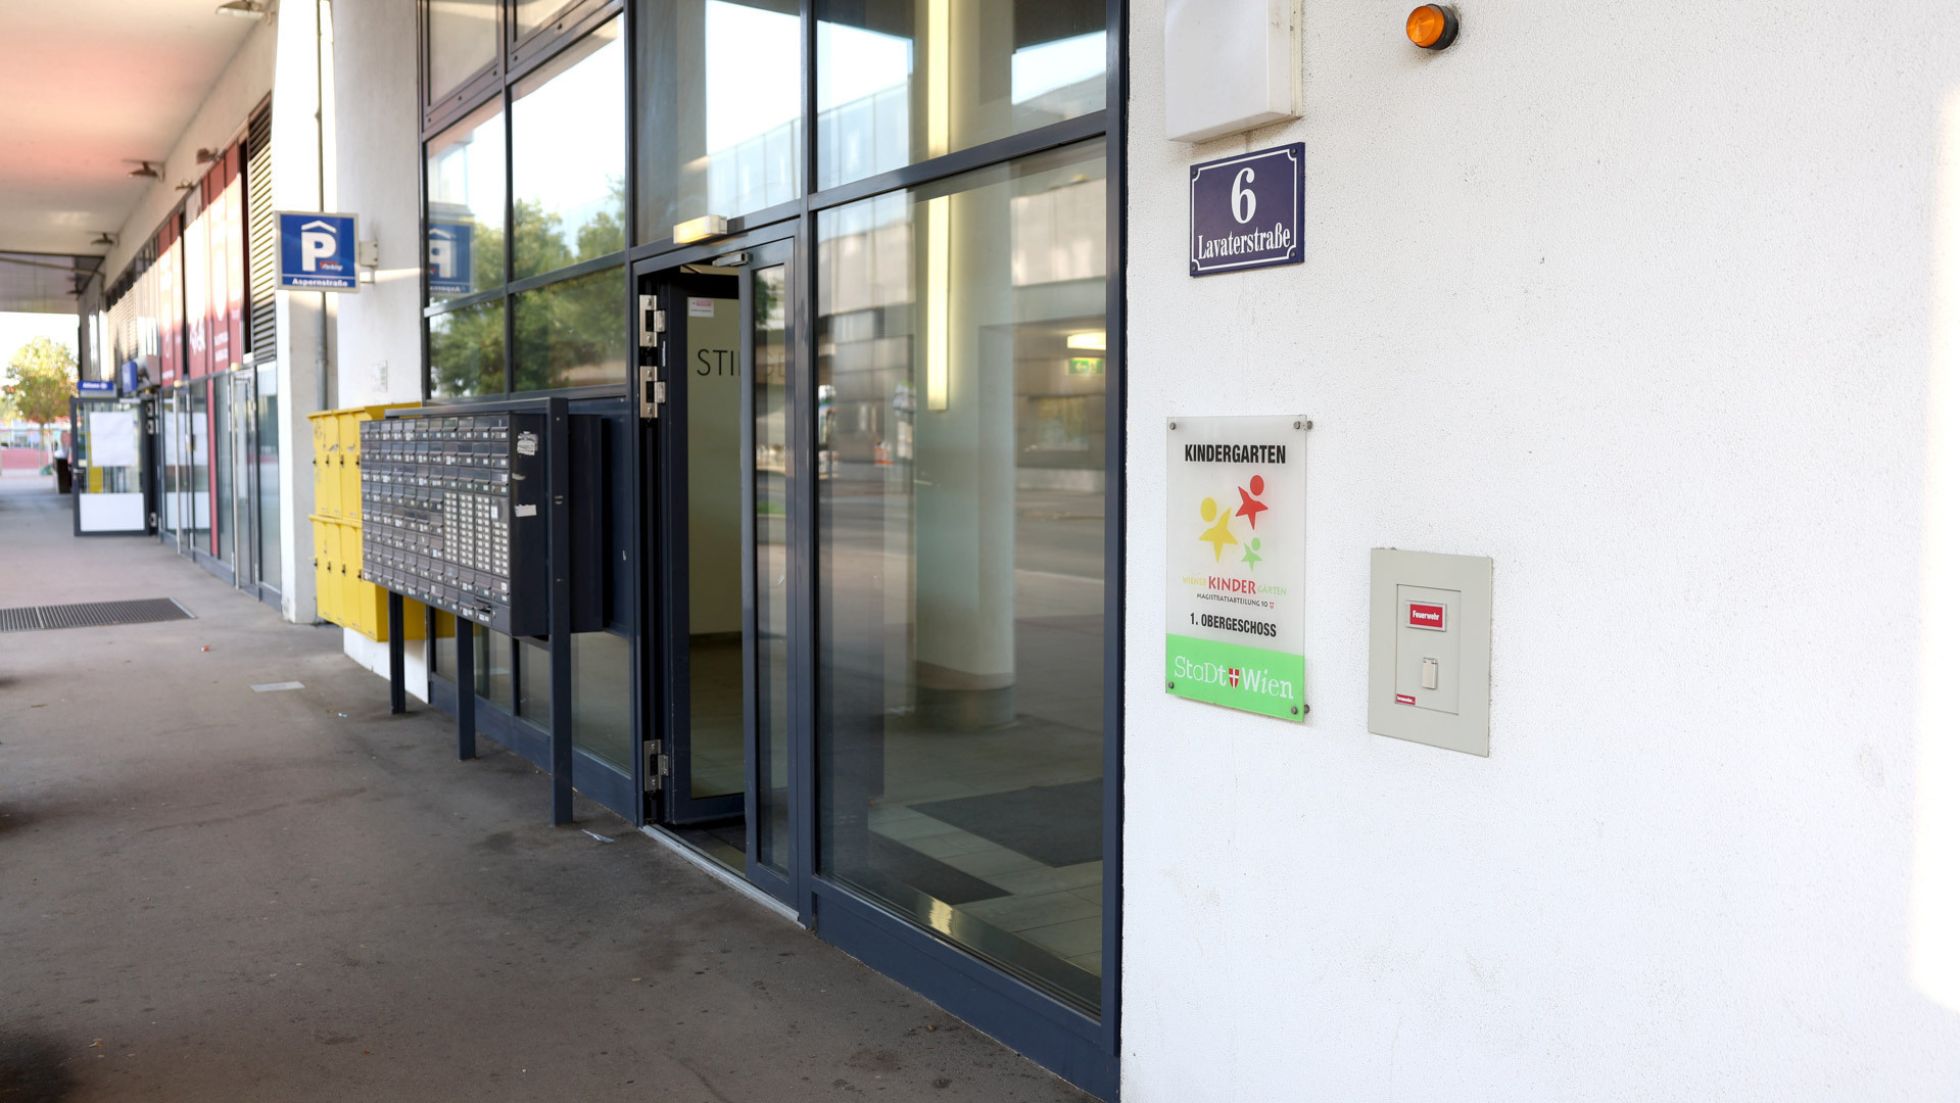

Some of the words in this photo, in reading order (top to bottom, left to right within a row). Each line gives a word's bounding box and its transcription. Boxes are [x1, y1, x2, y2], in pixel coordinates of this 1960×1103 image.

[1231, 167, 1257, 224] 6
[301, 231, 337, 272] P
[1198, 222, 1291, 259] Lavaterstraße
[292, 278, 348, 287] Aspernstraße
[696, 348, 741, 377] STI
[1184, 443, 1286, 464] KINDERGARTEN
[1208, 575, 1256, 595] KINDER
[1196, 592, 1260, 607] MAGISTRATSABTEILUNG
[1261, 600, 1268, 608] 10
[1190, 612, 1199, 626] 1.
[1201, 613, 1277, 638] OBERGESCHOSS
[1412, 609, 1440, 622] Feuerwehr
[1241, 667, 1294, 700] Wien
